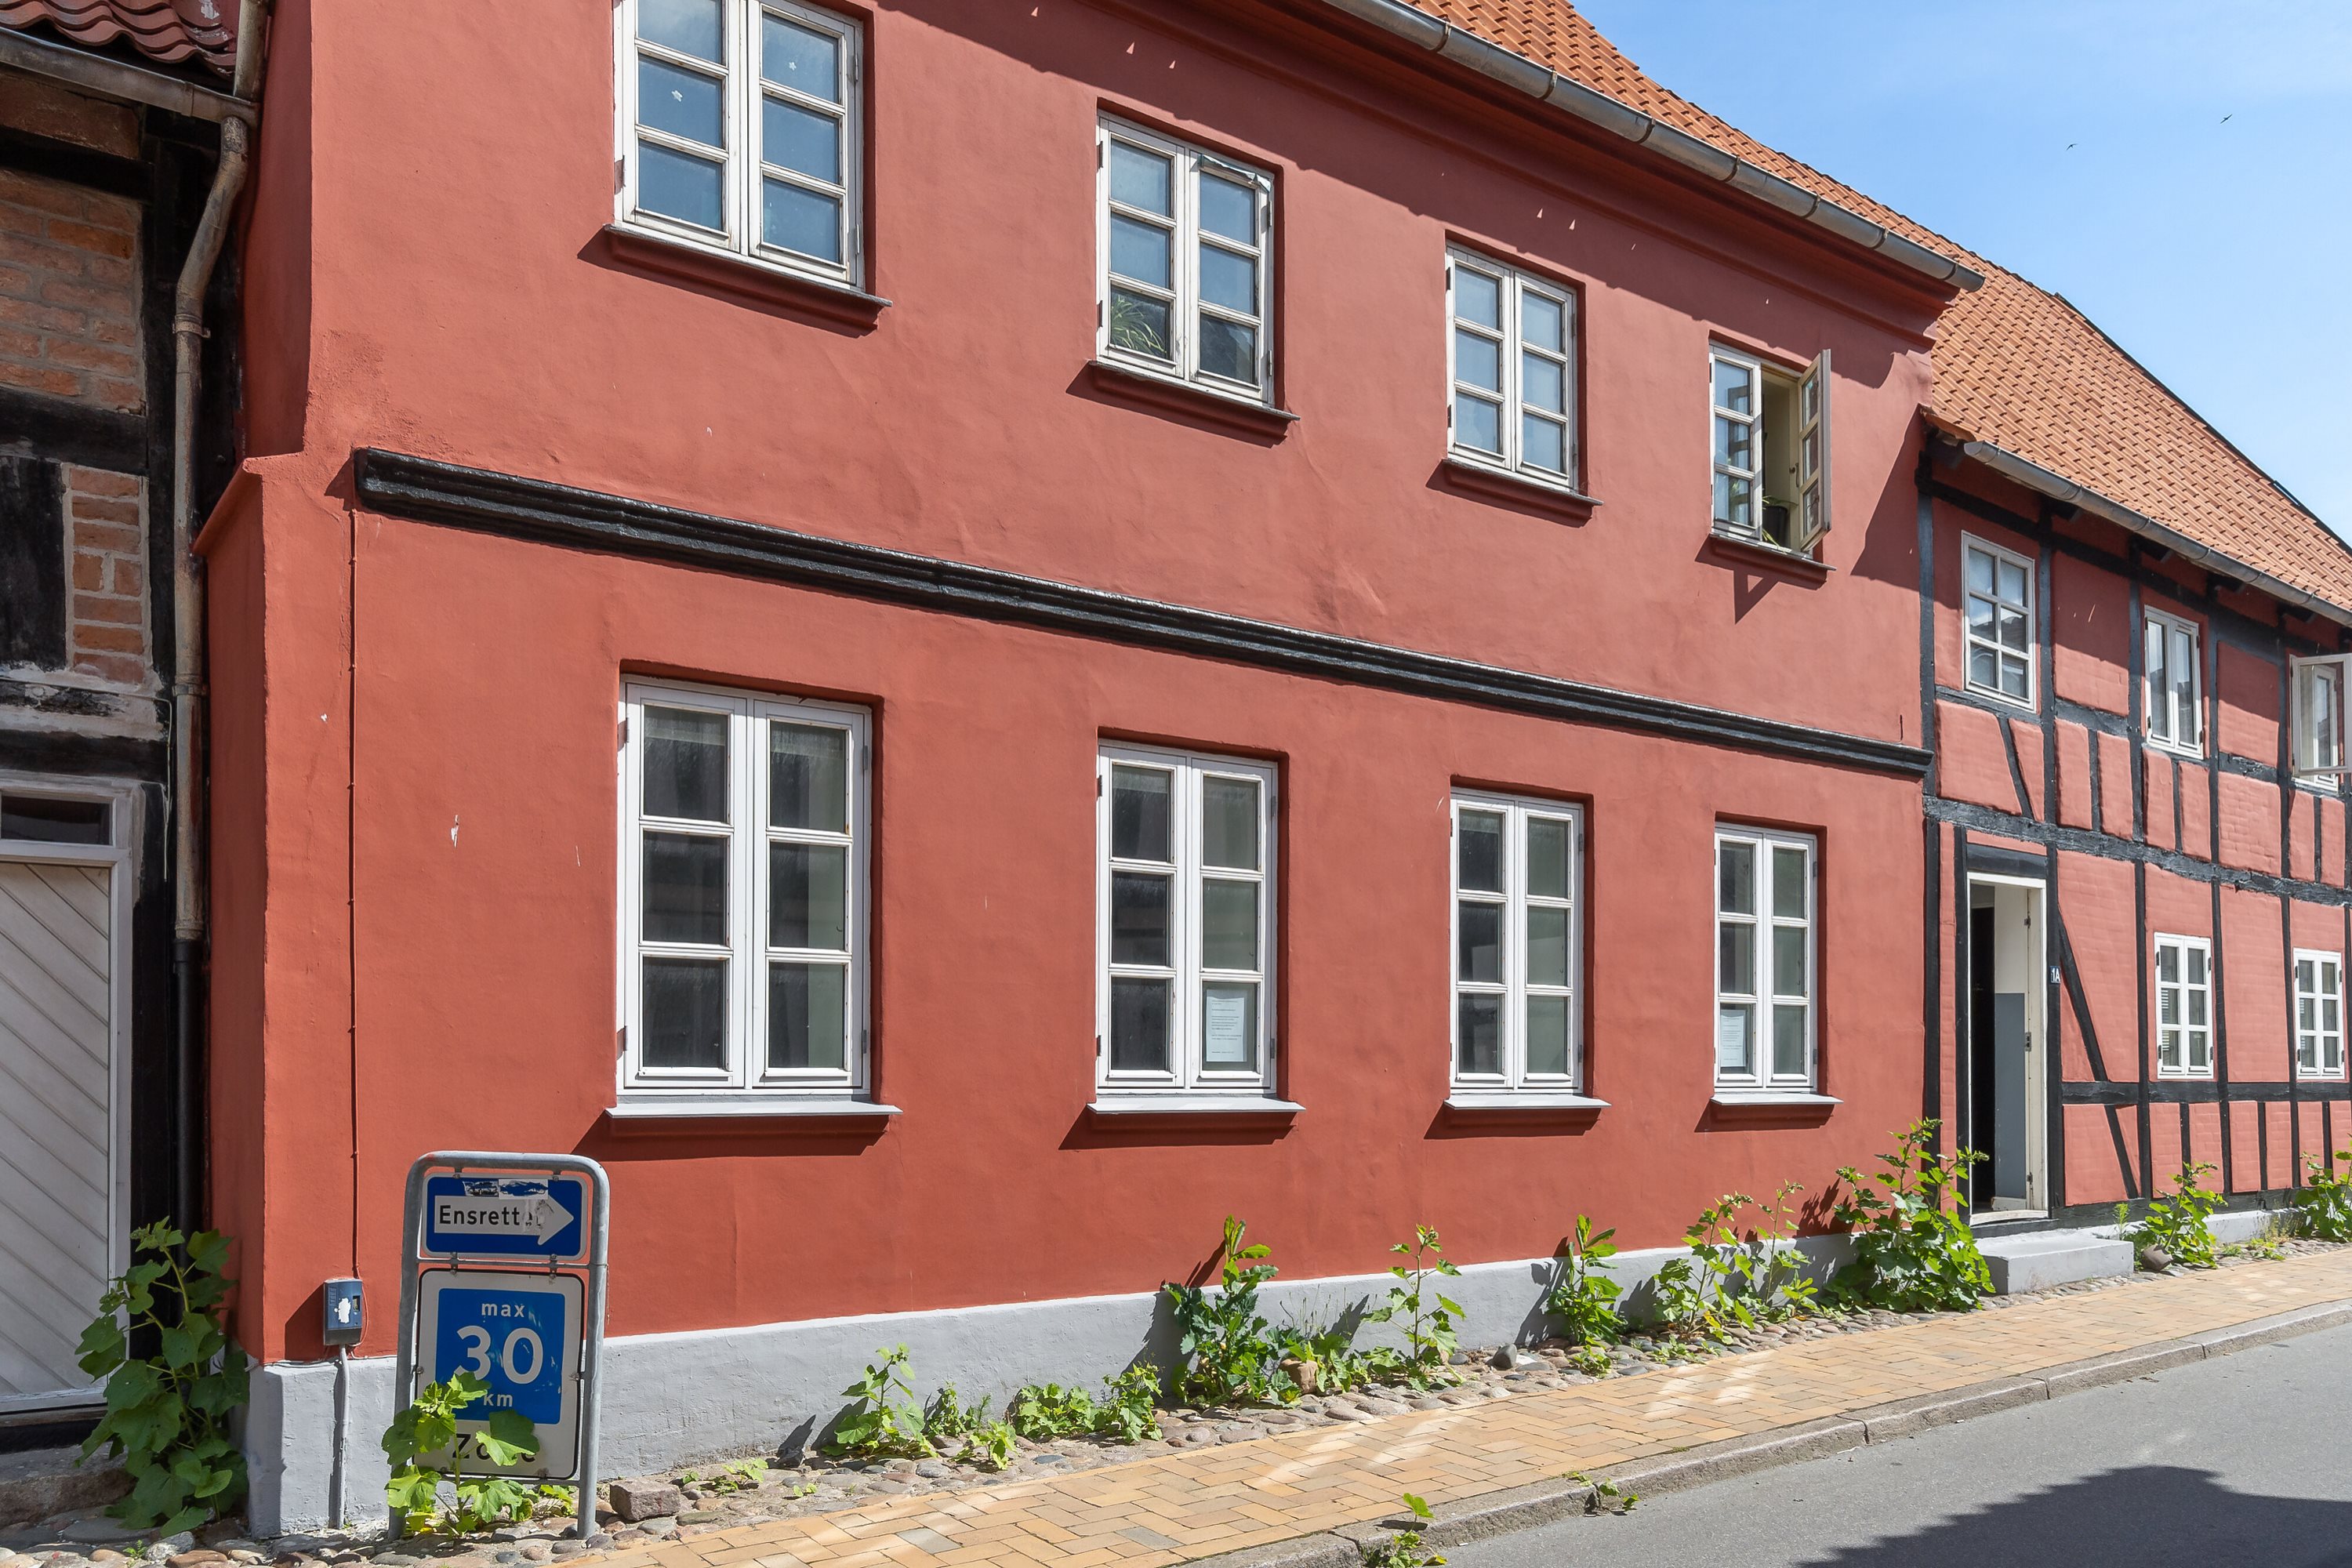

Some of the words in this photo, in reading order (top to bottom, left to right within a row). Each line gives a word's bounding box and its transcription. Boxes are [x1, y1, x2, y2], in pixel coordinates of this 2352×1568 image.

[2052, 967, 2061, 982] 1A
[481, 1302, 525, 1318] max
[453, 1325, 543, 1385] 30
[483, 1392, 513, 1407] km
